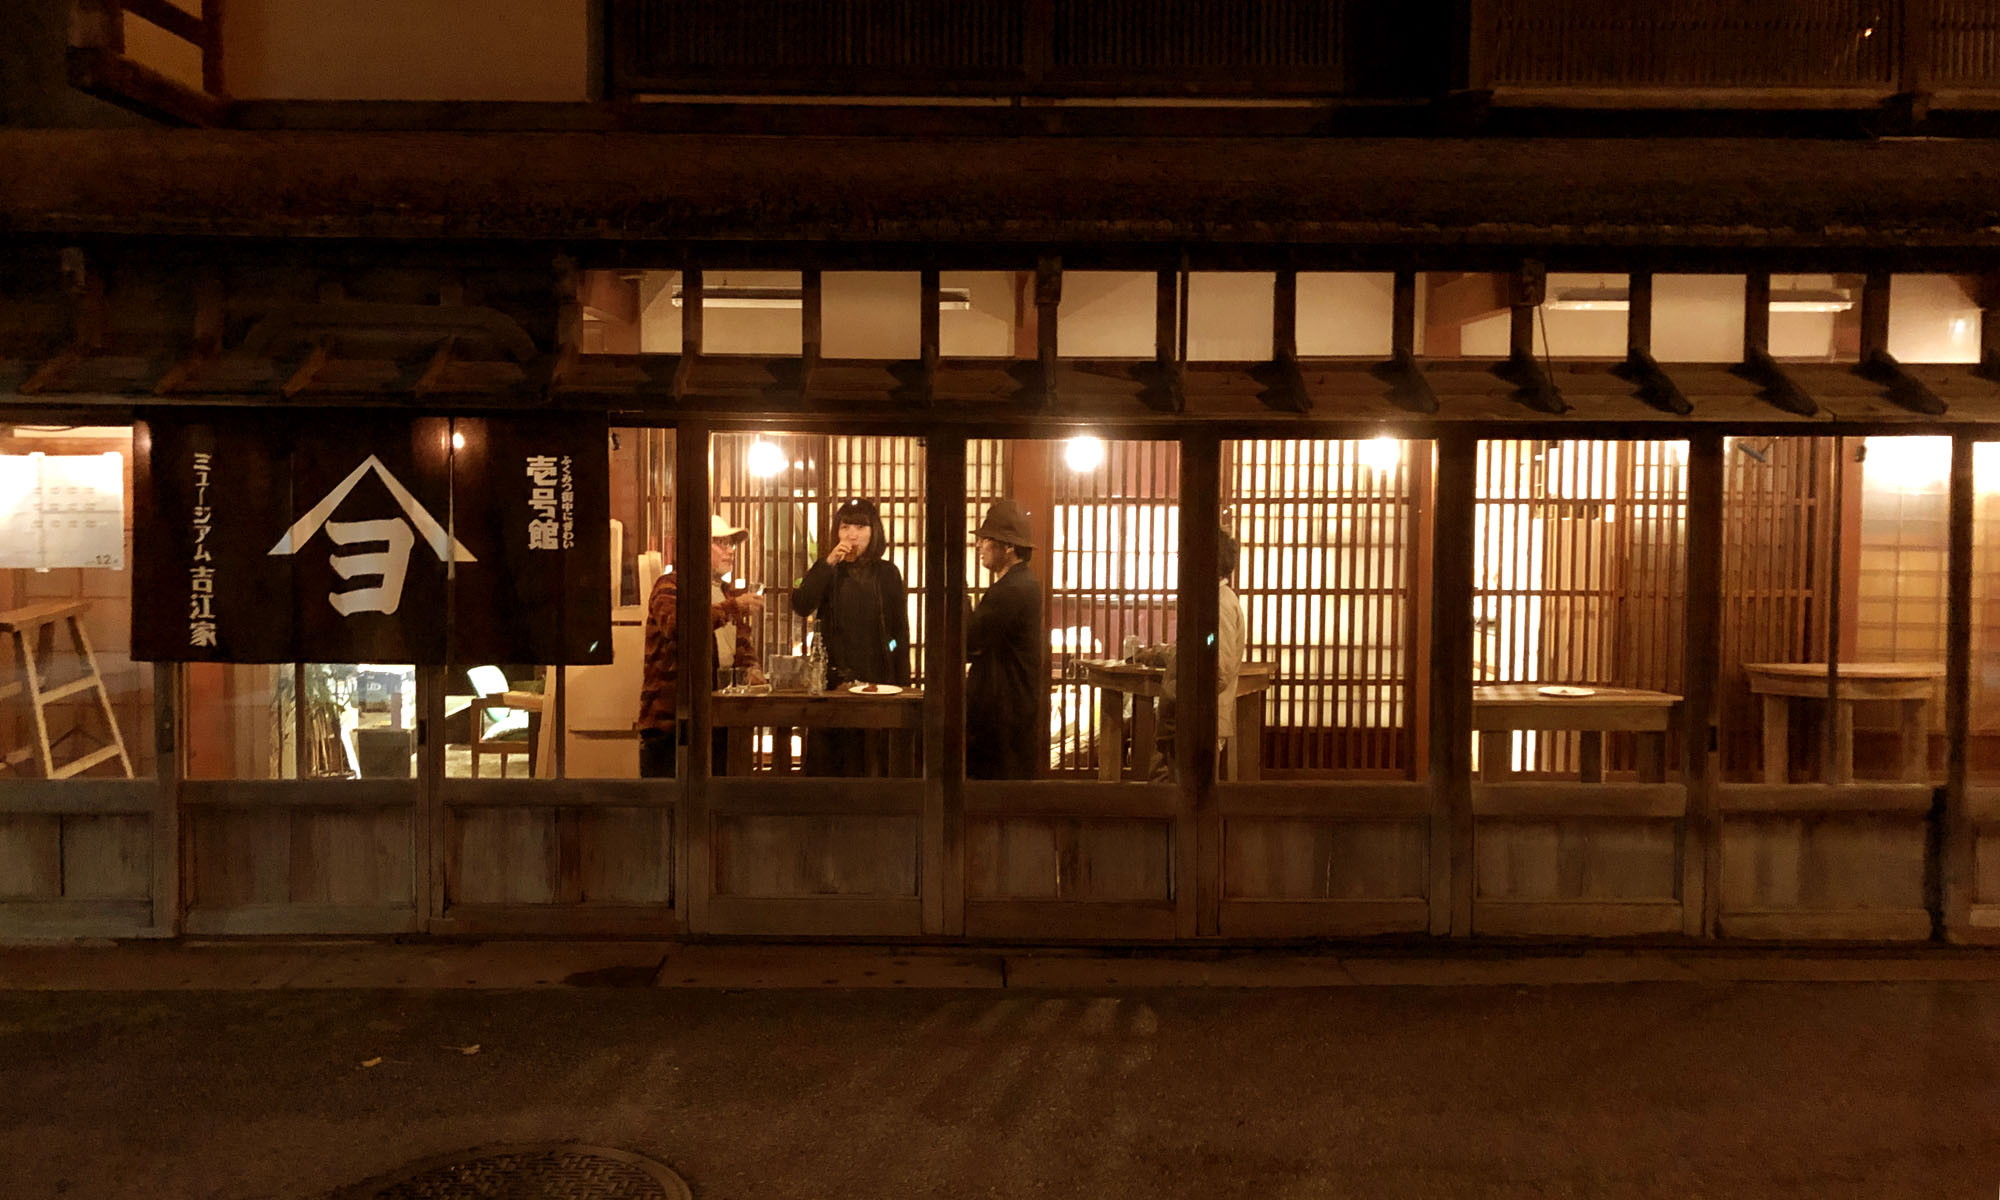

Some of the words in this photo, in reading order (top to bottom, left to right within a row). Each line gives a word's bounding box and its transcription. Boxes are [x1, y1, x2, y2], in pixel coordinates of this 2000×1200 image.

[189, 453, 217, 647] ミュージアム吉江家
[526, 455, 559, 550] 壱号館
[325, 518, 415, 617] ヨ
